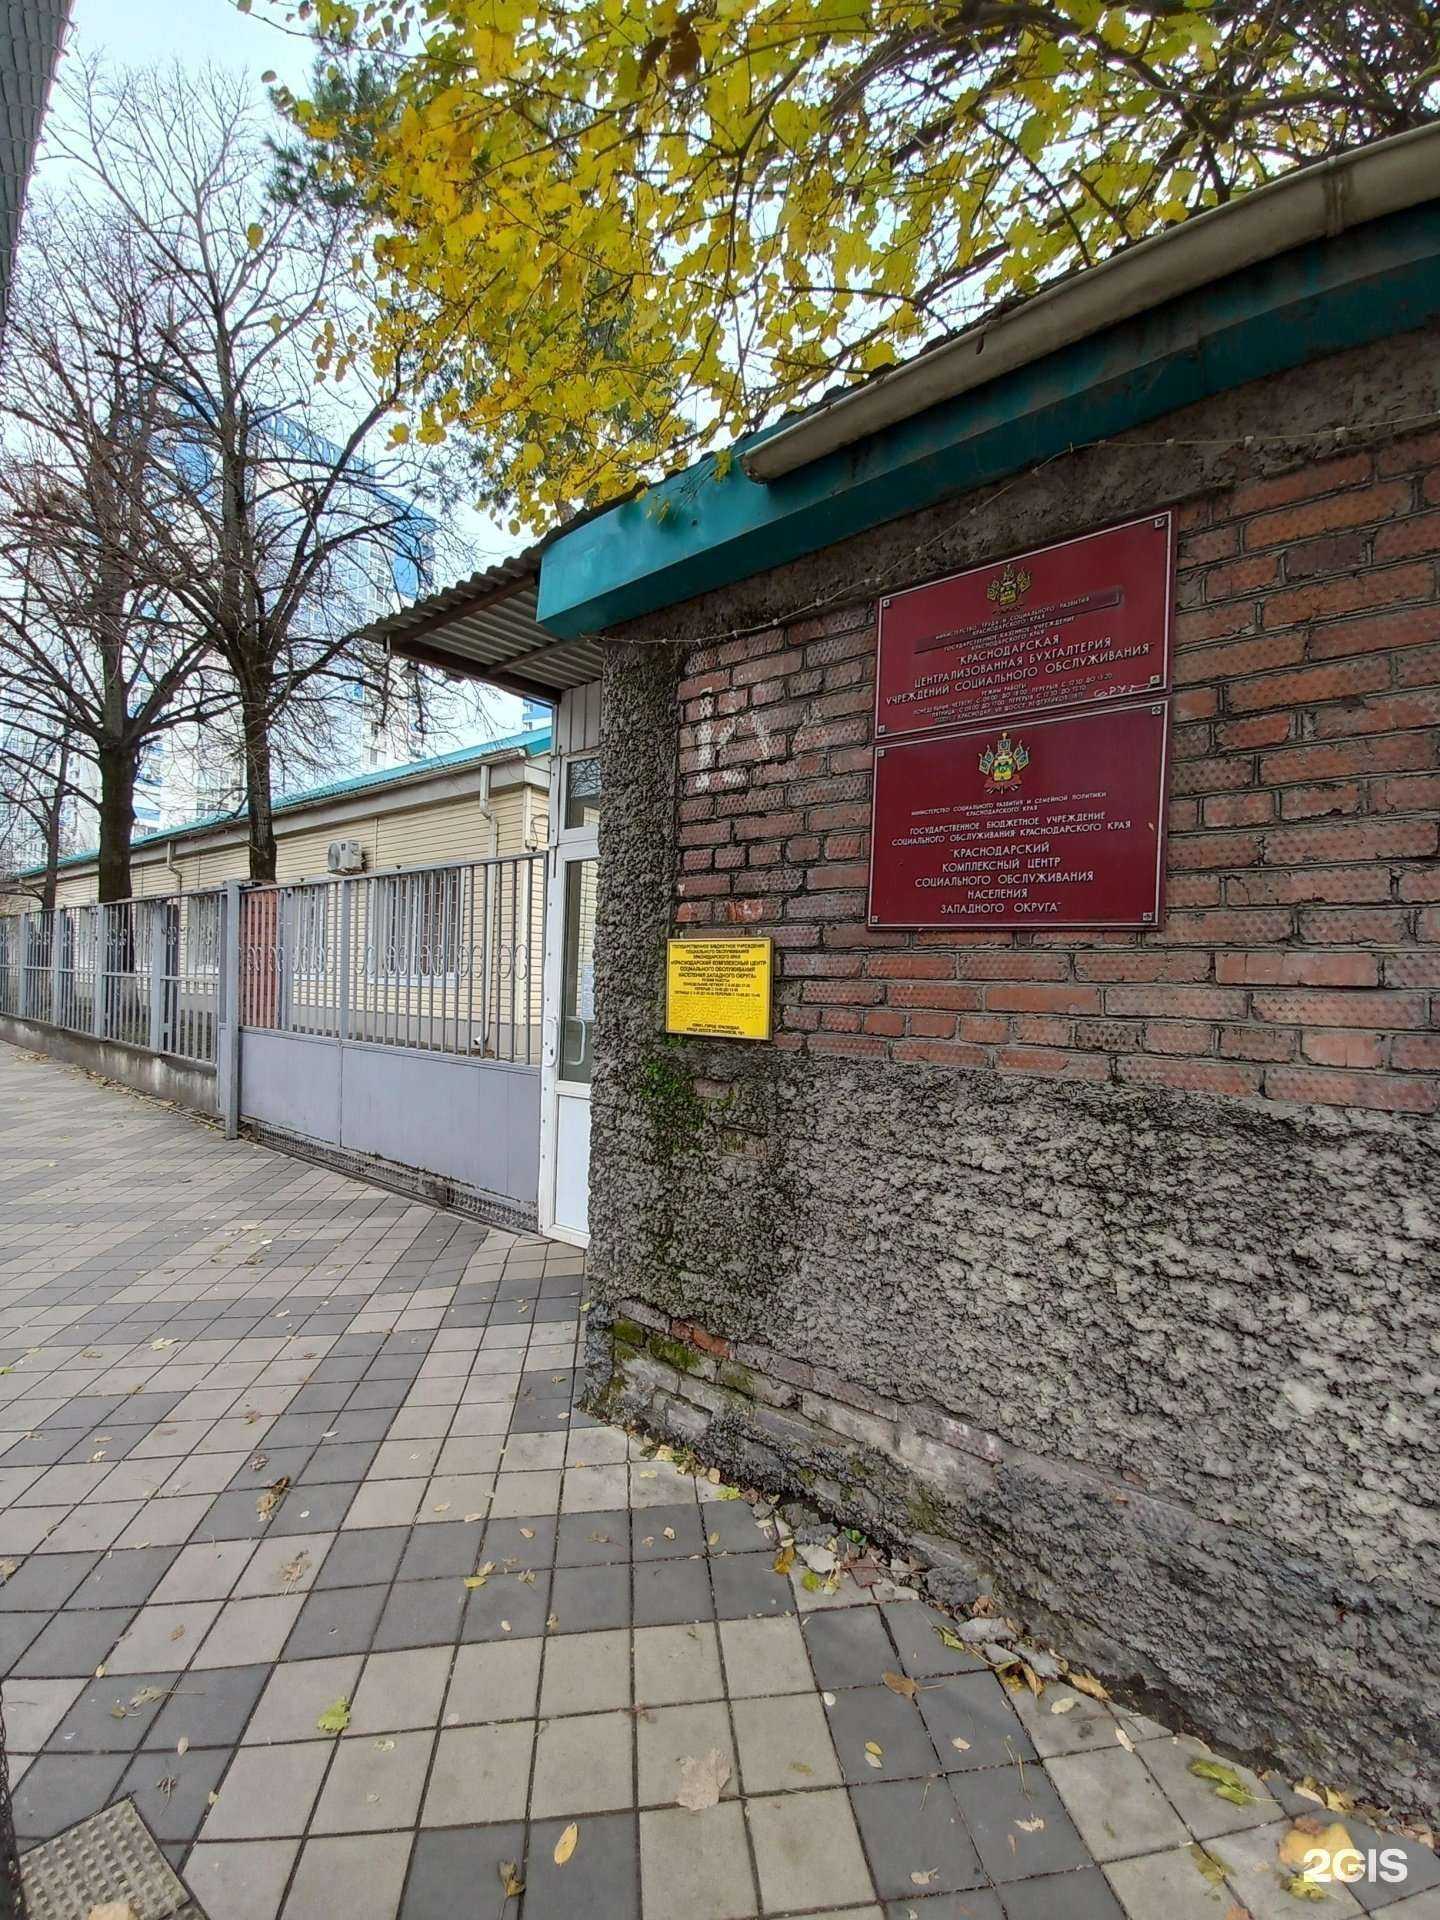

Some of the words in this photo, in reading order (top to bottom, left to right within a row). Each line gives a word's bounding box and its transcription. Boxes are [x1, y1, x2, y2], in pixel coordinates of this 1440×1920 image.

[914, 656, 1024, 689] ЦЕНТРАЛИЗОВАННАЯ
[1029, 637, 1112, 664] БУХГАЛТЕРИЯ
[886, 684, 950, 705] УЧРЕЖДЕНИЙ
[954, 666, 1038, 692] СОЦИАЛЬНОГО
[910, 822, 981, 835] ГОСУДАРСТВЕННОЕ
[986, 817, 1040, 829] БЮДЖЕТНОЕ
[1046, 811, 1106, 824] УЧРЕЖДЕНИЕ
[891, 835, 946, 847] СОЦИАЛЬНОГО
[949, 829, 1016, 843] ОБСЛУЖИВАНИЯ
[1019, 823, 1102, 837] КРАСНОДАРСКОГО
[1107, 820, 1131, 831] КРАЯ
[942, 858, 1020, 873] КОМПЛЕКСНЫЙ
[1027, 857, 1062, 869] ЦЕНТР
[915, 875, 992, 888] СОЦИАЛЬНОГО
[997, 871, 1095, 885] ОБСЛУЖИВАНИЯ
[967, 888, 1029, 900] НАСЕЛЕНИЯ
[940, 902, 1005, 914] ЗАПАДНОГО
